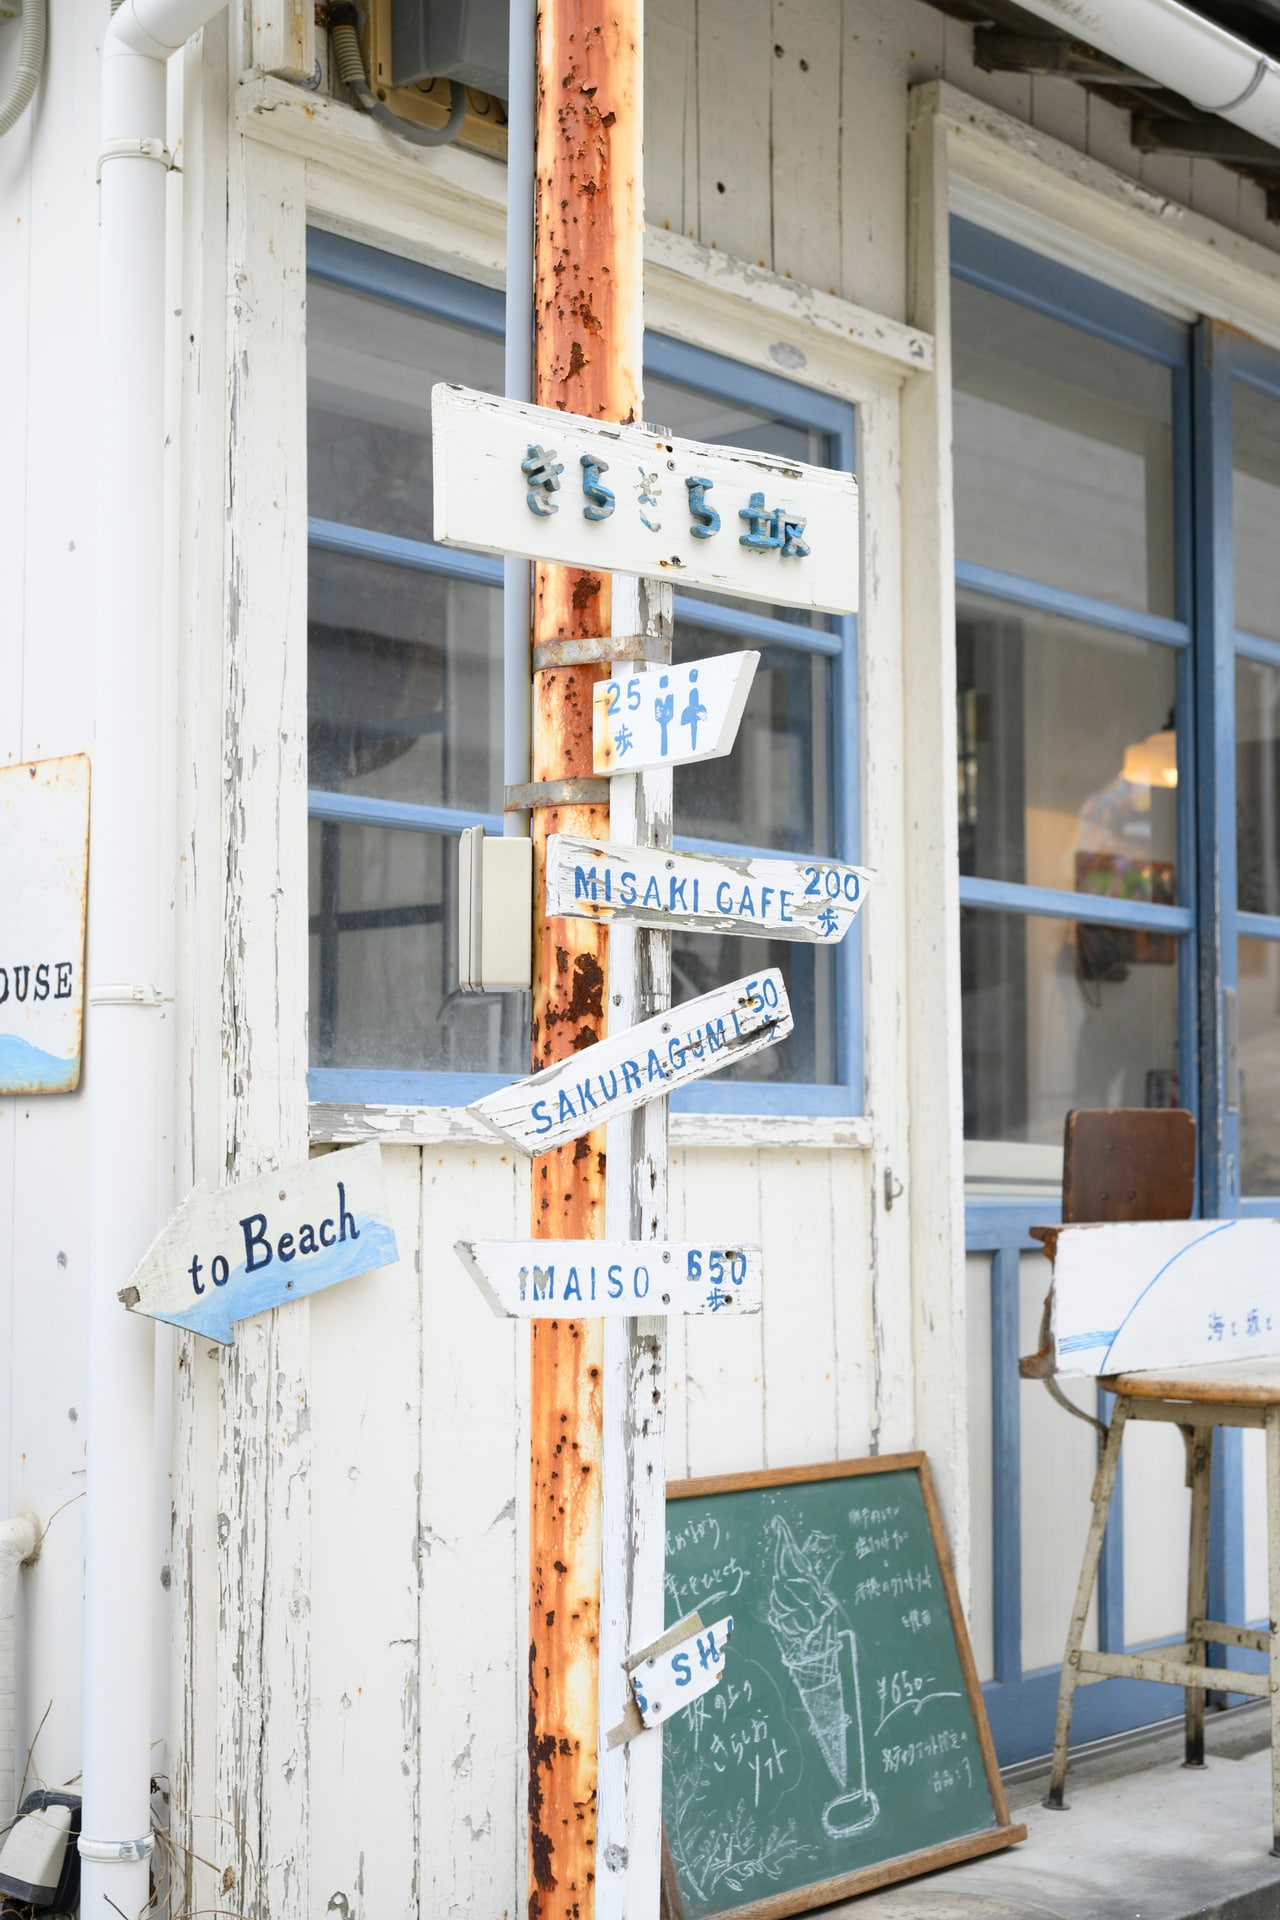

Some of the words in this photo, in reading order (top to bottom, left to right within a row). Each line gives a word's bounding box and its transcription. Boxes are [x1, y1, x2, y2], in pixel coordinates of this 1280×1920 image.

[521, 443, 811, 559] きらきら坂
[606, 679, 642, 717] 25
[614, 723, 634, 758] 歩
[574, 865, 700, 913] MISAKI
[716, 881, 795, 922] CAFE
[804, 866, 860, 902] 200
[817, 907, 839, 938] 歩
[744, 978, 779, 1014] 50
[187, 1254, 230, 1295] to
[239, 1181, 361, 1274] Beach
[517, 1264, 650, 1301] IMAISO
[686, 1249, 747, 1286] 650
